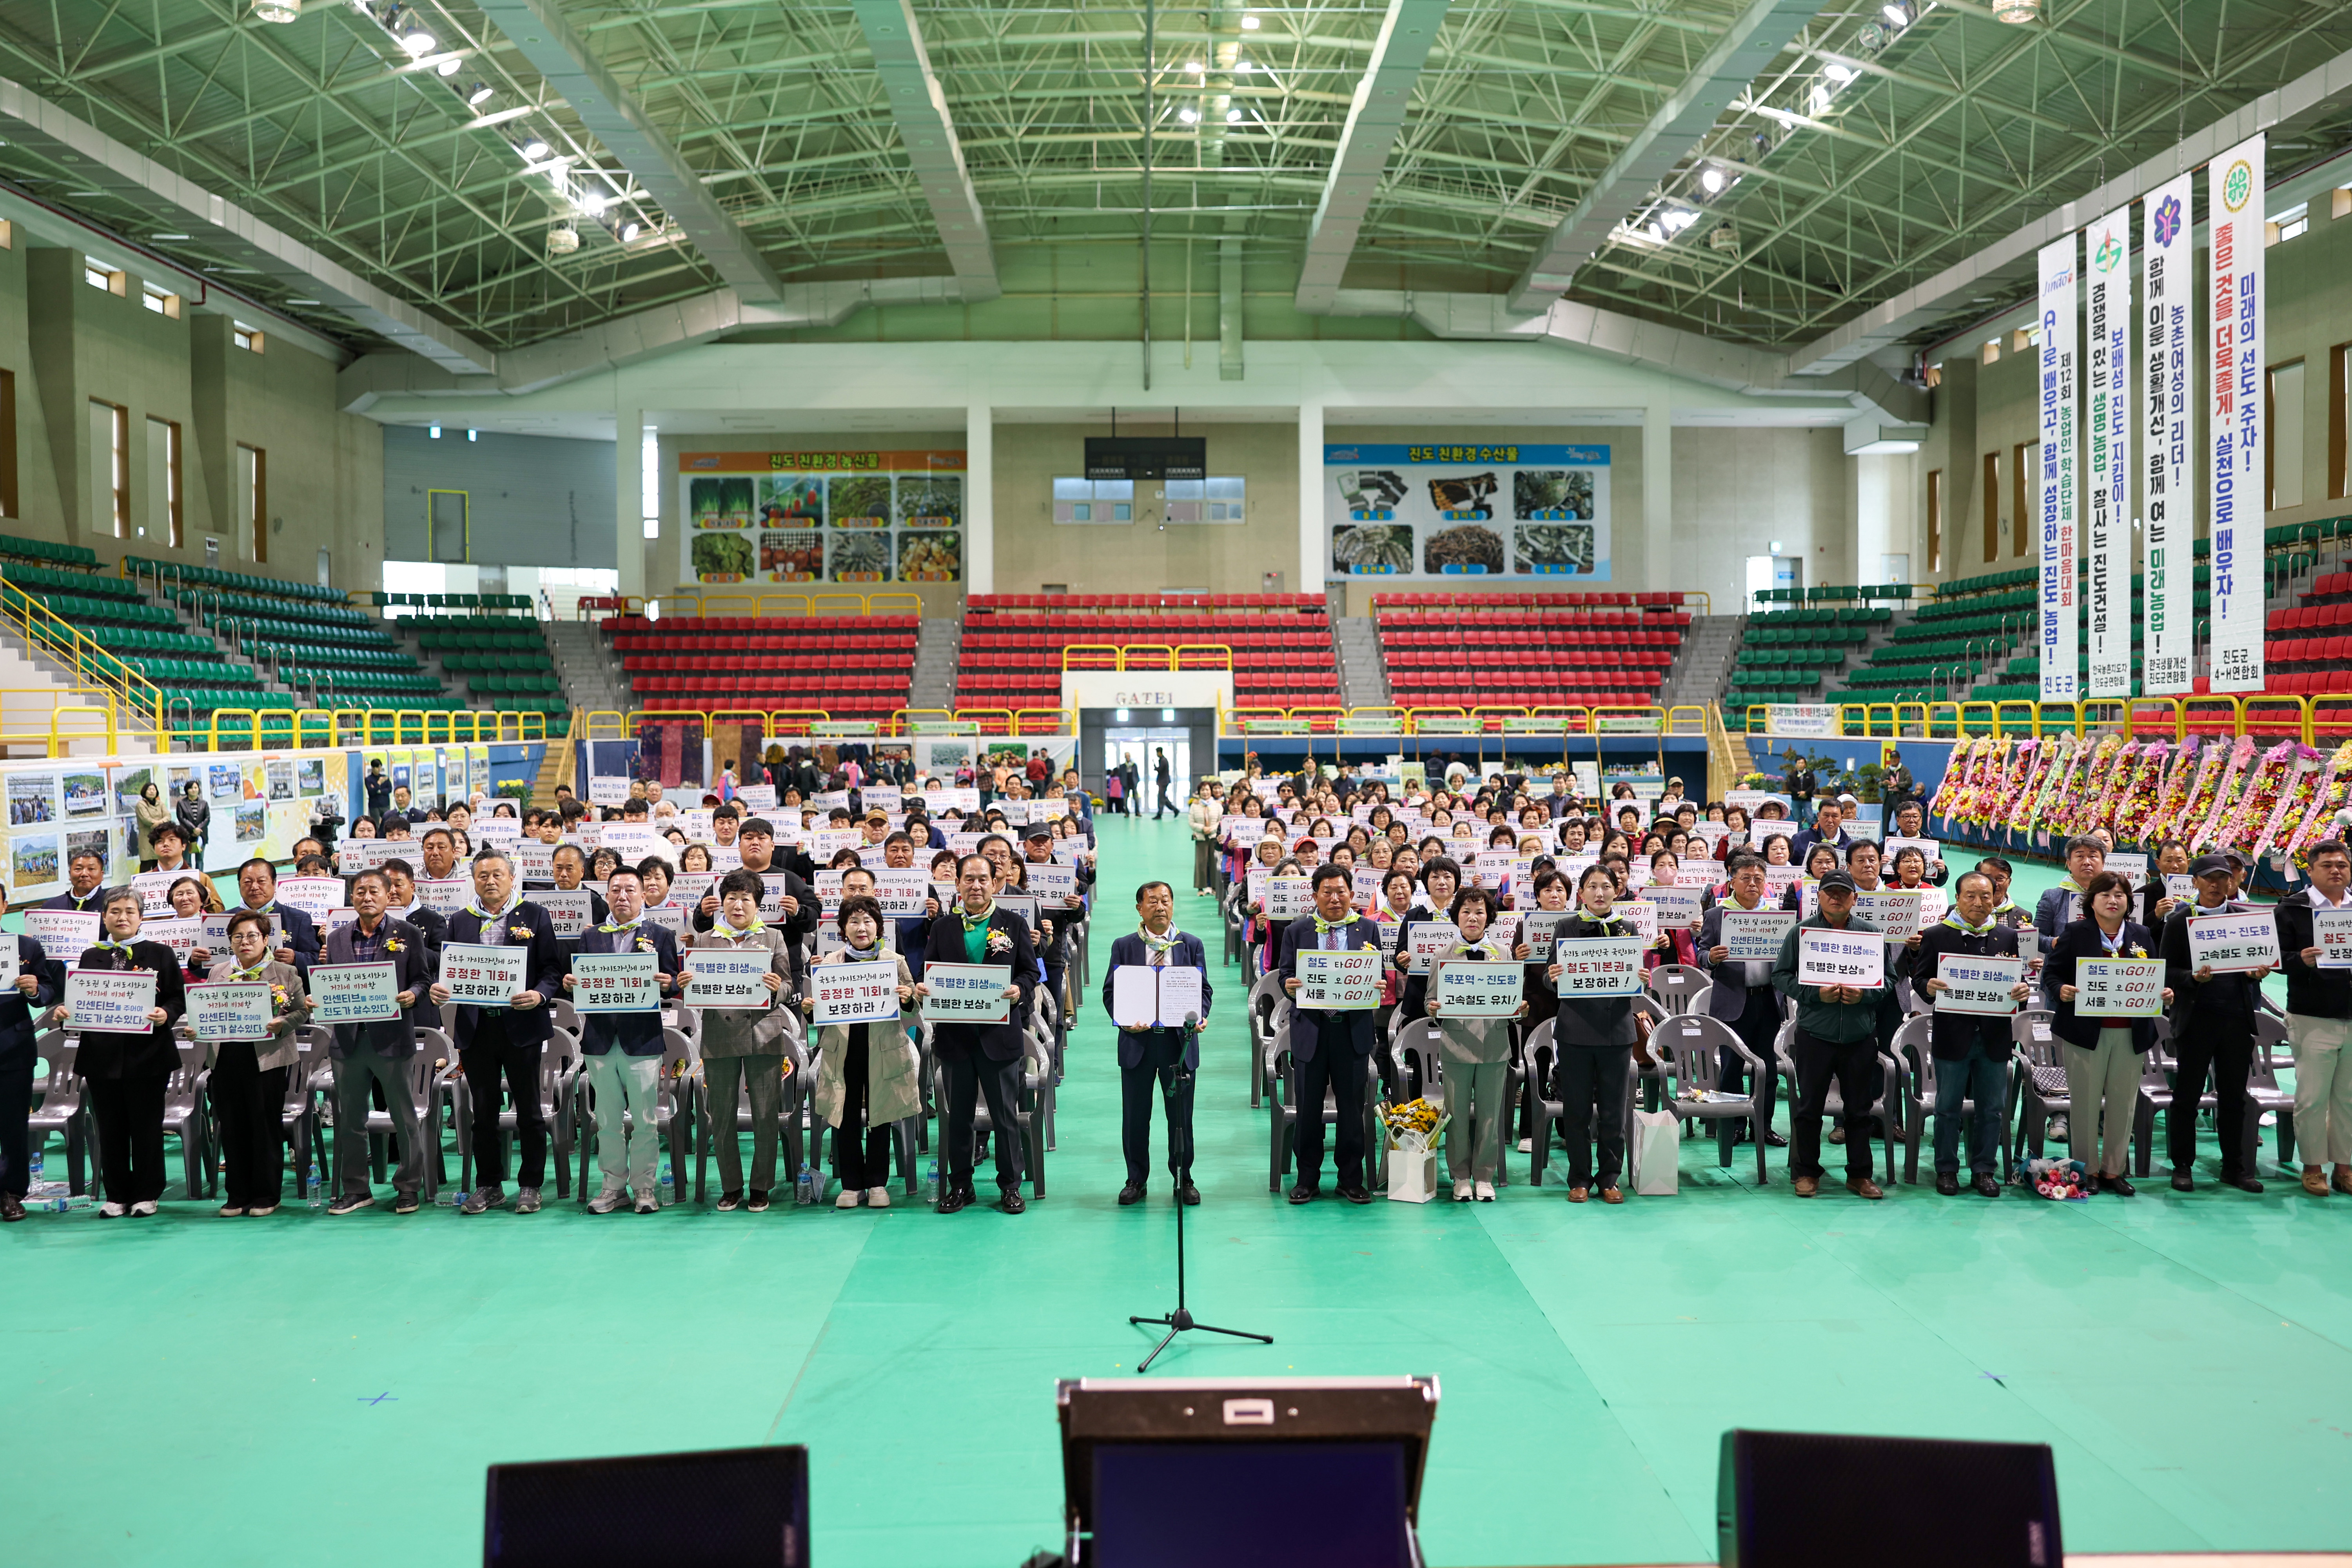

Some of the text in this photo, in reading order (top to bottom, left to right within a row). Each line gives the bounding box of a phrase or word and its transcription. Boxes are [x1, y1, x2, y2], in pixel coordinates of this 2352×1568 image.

[2216, 222, 2232, 271] 좋은
[2150, 256, 2164, 299] 함께
[2216, 273, 2232, 321] 것을
[2240, 272, 2257, 472] 미래의 선도 주자!
[2150, 350, 2164, 445] 생활개선,
[2171, 306, 2184, 486] 농촌여성의 리더!
[2112, 327, 2123, 523] 보배섬 진도 지킴이!
[1408, 446, 1519, 462] 진도 친환경 수산물
[769, 453, 880, 469] 진도 친환경 농산물
[2093, 282, 2107, 653] 경쟁력 있는 생명농업, 잘사는 진도건설!
[2060, 352, 2073, 606] 제12회 농업인 학습단체 한마음대회
[2150, 453, 2165, 495] 함께
[2216, 433, 2233, 524] 실천으로
[2043, 310, 2057, 665] AI로 배우고, 함께 성장하는 진도 농업!
[2150, 500, 2164, 543] 여는
[2216, 529, 2233, 619] 배우자!
[2150, 548, 2164, 653] 미래농업!
[2223, 649, 2248, 664] 진도군
[2093, 663, 2127, 675] 한국농촌지도자
[2149, 657, 2186, 671] 한국생활개선
[2150, 671, 2186, 684] 진도군연합회
[2215, 665, 2258, 680] 4-H연합회
[2095, 677, 2124, 688] 진도군연합회
[1582, 949, 1609, 957] 대한민국
[1612, 948, 1638, 956] 국민이다.
[1842, 945, 1878, 956] 희생에는,
[2200, 946, 2273, 961] 고속철도 유치!
[447, 954, 464, 963] 국토부
[467, 956, 505, 965] 가이드라인에
[1308, 957, 1327, 967] 철도
[729, 963, 765, 974] 희생에는,
[1567, 962, 1633, 973] 철도기본권을
[1806, 962, 1836, 973] 특별한
[2088, 965, 2108, 975] 철도
[344, 973, 350, 981] 및
[446, 967, 517, 981] 공정한 기회를
[819, 976, 837, 984] 국토부
[839, 973, 876, 982] 가이드라인에
[1307, 974, 1327, 984] 진도
[1983, 971, 2016, 982] 희생에는,
[581, 977, 651, 988] 공정한 기회를
[968, 979, 1005, 990] 희생에는,
[2087, 982, 2107, 991] 진도
[691, 984, 722, 994] 특별한
[820, 985, 890, 1000] 공정한 기회를
[1306, 989, 1325, 999] 서울
[1944, 989, 1975, 1000] 특별한
[222, 991, 229, 999] 및
[323, 994, 367, 1004] 인센티브를
[1445, 995, 1517, 1005] 고속철도 유치!
[76, 1000, 121, 1011] 인센티브를
[232, 1000, 252, 1009] 비례한
[930, 998, 961, 1009] 특별한
[2085, 997, 2106, 1007] 서울
[323, 1004, 392, 1016] 진도가 살수있다.
[74, 1013, 144, 1024] 진도가 살수있다.
[199, 1012, 241, 1022] 인센티브를
[199, 1024, 265, 1035] 진도가 살수있다.
